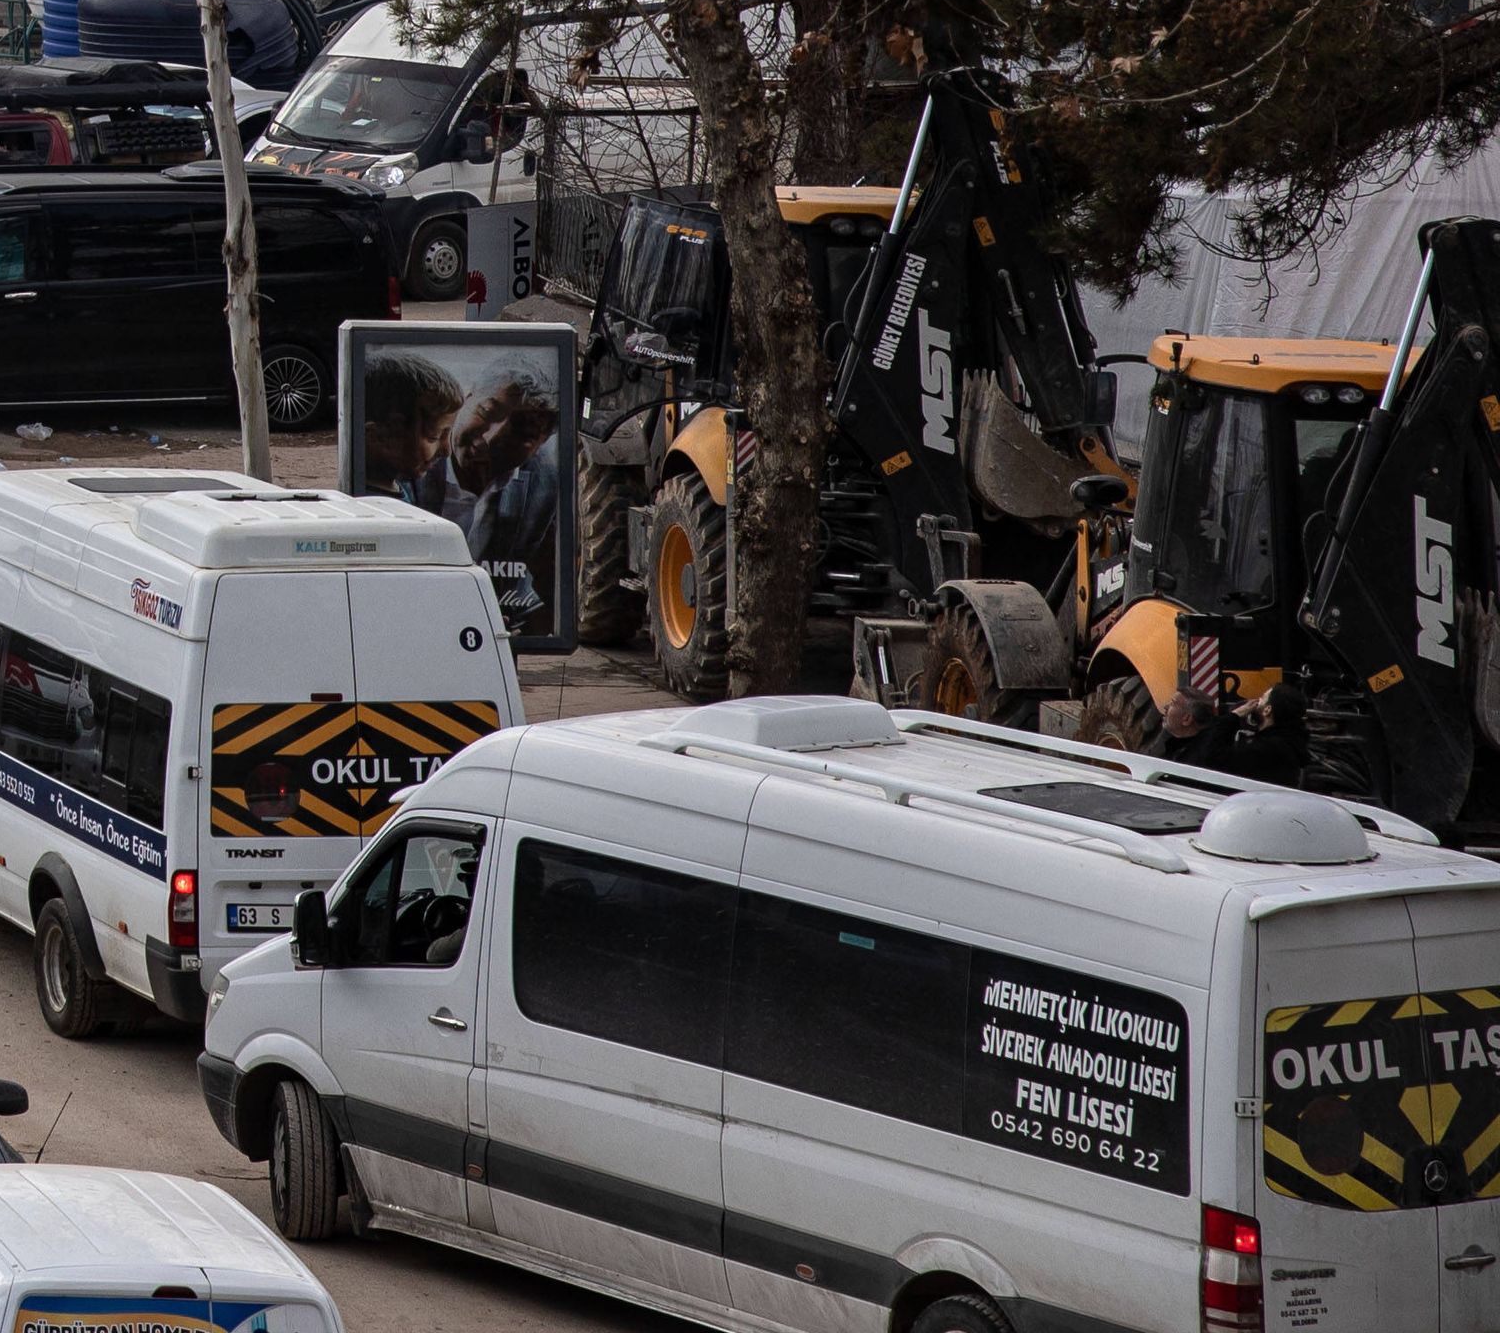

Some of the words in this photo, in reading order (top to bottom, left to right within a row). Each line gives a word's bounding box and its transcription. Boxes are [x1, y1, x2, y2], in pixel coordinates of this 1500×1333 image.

[887, 252, 927, 330] BELEDİYESİ
[632, 345, 696, 364] AUTOpowershift
[873, 326, 902, 371] GÜNEY
[918, 307, 956, 455] MST
[296, 541, 327, 553] KALE
[1097, 562, 1125, 598] MS
[1414, 494, 1456, 668] MST
[466, 630, 477, 648] 8
[6, 771, 18, 795] 552
[24, 782, 35, 805] 552
[312, 757, 401, 784] OKUL
[79, 804, 105, 840] İnsan,
[106, 818, 130, 853] Önce
[225, 848, 285, 858] TRANSIT
[238, 908, 257, 925] 63
[271, 908, 281, 925] S
[983, 978, 1089, 1034] MEHMETÇİK
[1090, 996, 1180, 1053] İLKOKULU
[981, 1017, 1047, 1068] SİVEREK
[1047, 1042, 1128, 1089] ANADOLU
[1129, 1055, 1177, 1102] LİSESİ
[1272, 1039, 1401, 1090] OKUL
[1433, 1024, 1500, 1076] TAŞ
[1016, 1077, 1062, 1118] FEN
[1067, 1086, 1135, 1138] LİSESİ
[991, 1110, 1044, 1141] 0542
[1051, 1127, 1092, 1154] 690
[1099, 1139, 1125, 1163] 64
[1133, 1148, 1161, 1173] 22
